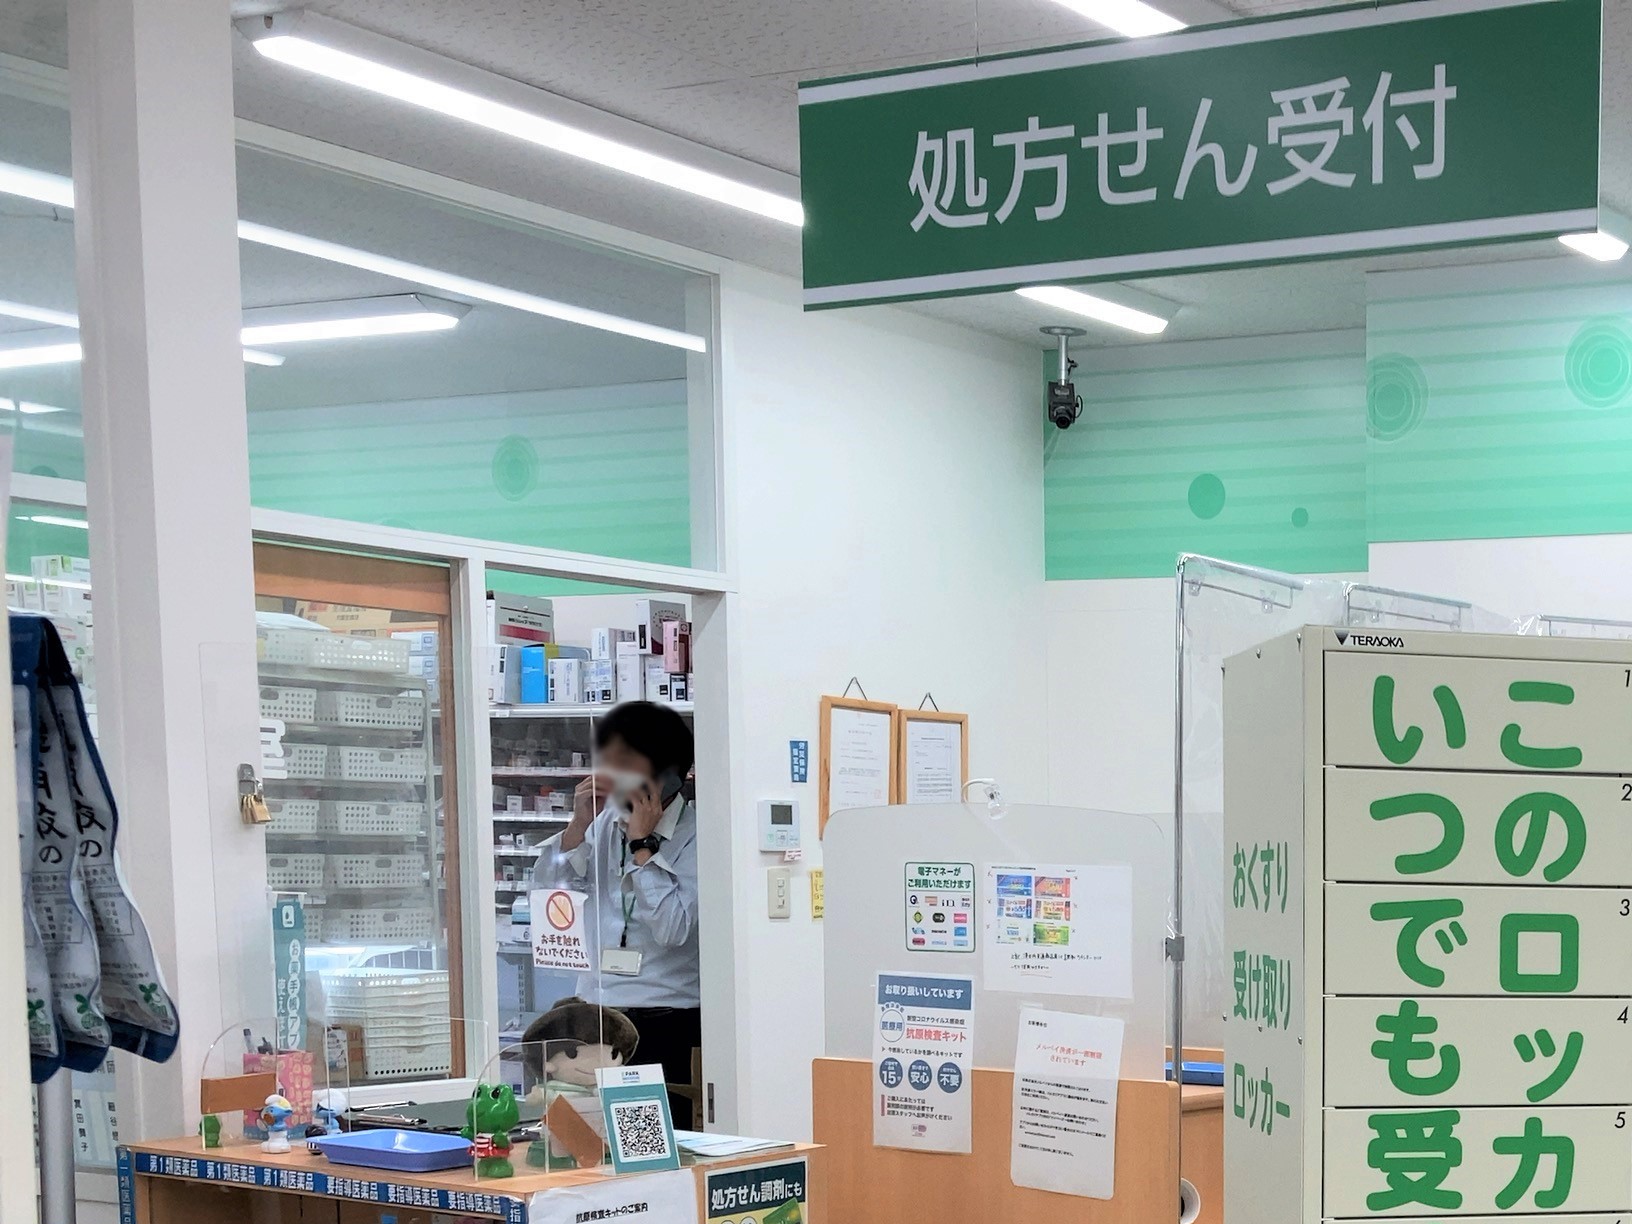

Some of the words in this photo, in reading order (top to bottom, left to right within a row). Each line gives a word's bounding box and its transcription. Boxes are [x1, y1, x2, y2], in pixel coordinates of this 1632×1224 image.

[908, 64, 1457, 233] 処方せん受付
[1351, 634, 1404, 648] TERAOKA
[1623, 668, 1632, 689] 1
[917, 866, 961, 877] 電子マネーが
[1231, 840, 1289, 915] おくすり
[908, 878, 971, 889] ご利用いただけます
[1619, 898, 1631, 917] 3
[541, 934, 580, 946] お手を触れ
[536, 946, 588, 959] ないでください
[885, 984, 963, 1000] お取り扱いしています
[1231, 949, 1292, 1031] 受け取り
[1616, 1006, 1630, 1025] 4
[881, 1020, 903, 1032] 医療用
[906, 1028, 967, 1043] 抗原検査キット
[882, 1070, 897, 1085] 15
[910, 1072, 930, 1084] 安心
[940, 1073, 960, 1087] 不要
[1233, 1064, 1291, 1138] ロッカー
[1614, 1111, 1627, 1130] 5
[149, 1155, 199, 1178] 第1類医薬品
[206, 1162, 256, 1185] 第1類医薬品
[263, 1168, 314, 1192] 第1類医薬品
[326, 1175, 379, 1201] 要指導医薬品
[386, 1183, 440, 1208] 要指導医薬品
[447, 1190, 501, 1214] 要指導医薬品
[711, 1177, 803, 1210] 処方せん調剤にも
[576, 1202, 648, 1224] 抗原検査キットのご案内
